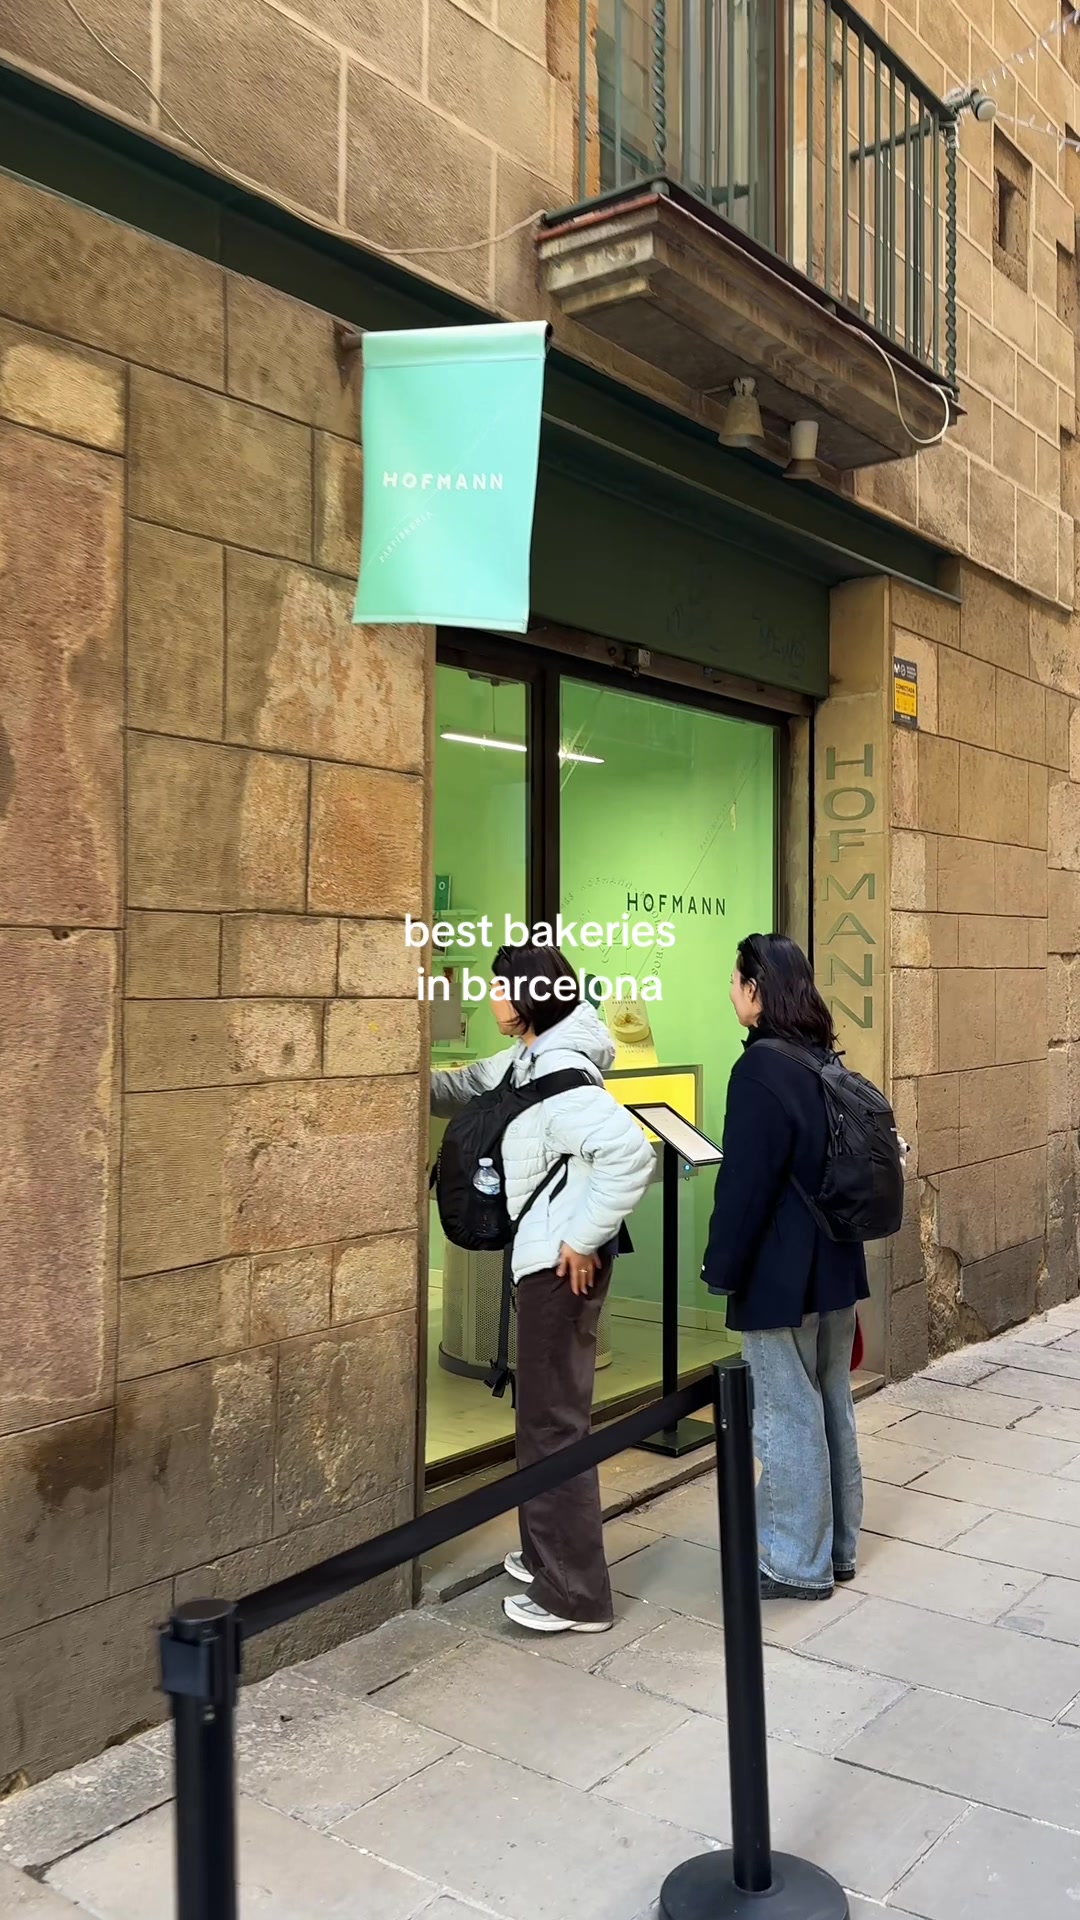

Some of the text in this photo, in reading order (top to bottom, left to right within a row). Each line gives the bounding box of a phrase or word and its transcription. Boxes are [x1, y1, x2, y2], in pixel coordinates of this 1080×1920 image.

[383, 471, 504, 490] HOFMANN
[820, 743, 877, 1029] HOFMANN
[627, 892, 725, 915] HOFMANN
